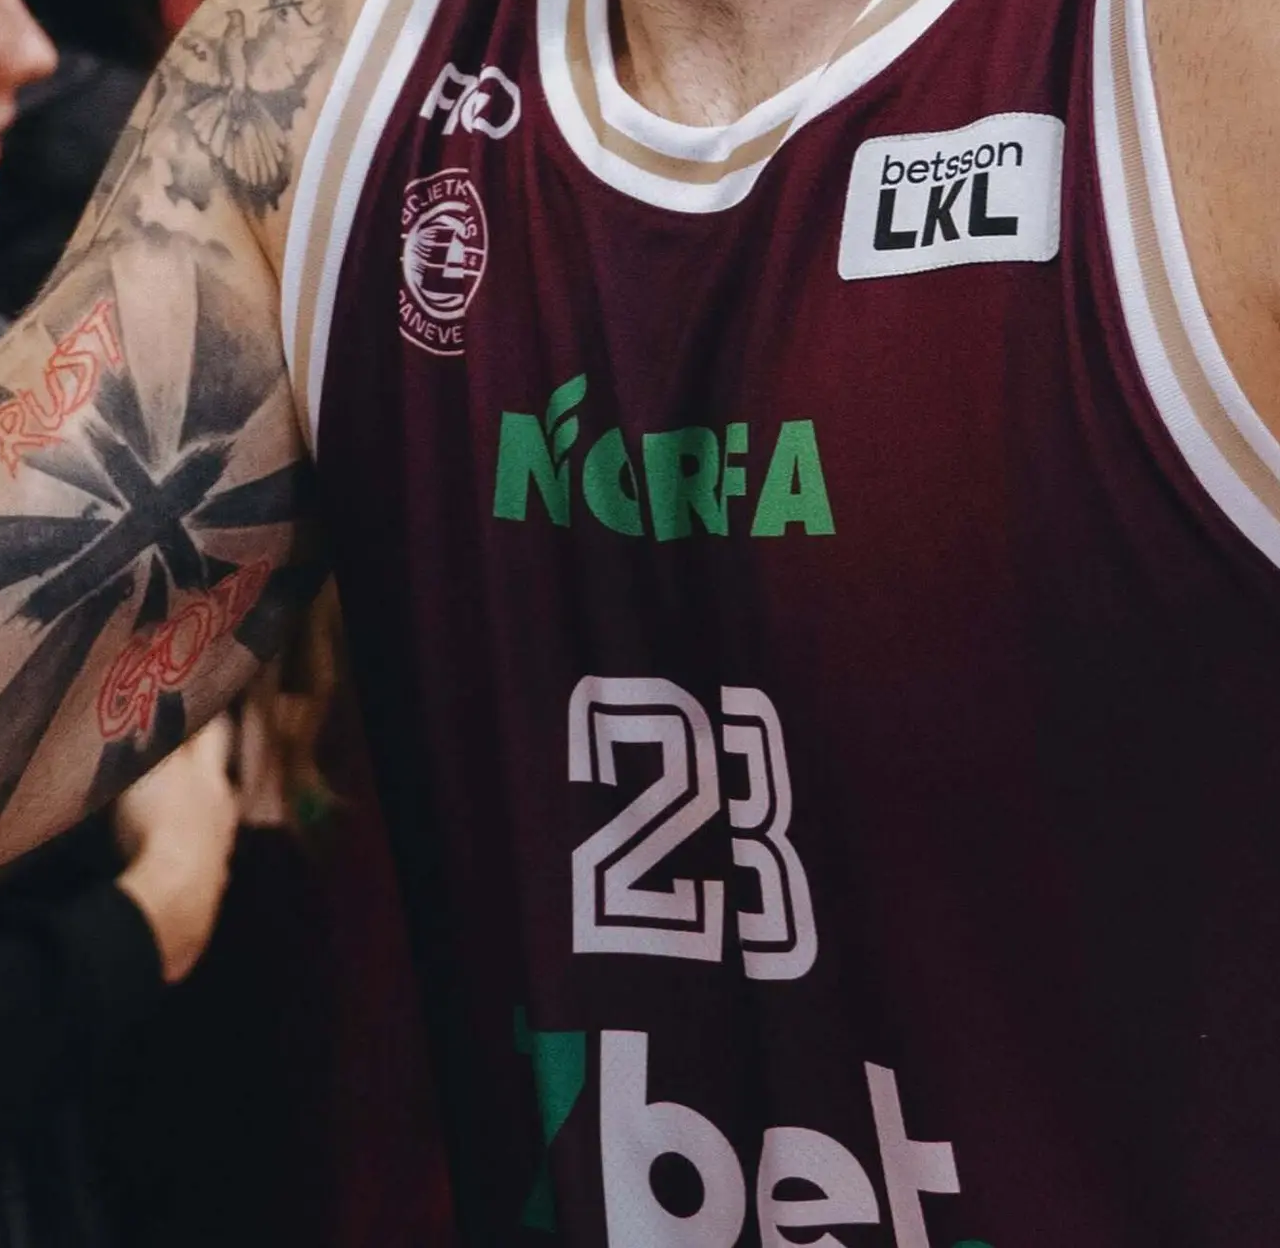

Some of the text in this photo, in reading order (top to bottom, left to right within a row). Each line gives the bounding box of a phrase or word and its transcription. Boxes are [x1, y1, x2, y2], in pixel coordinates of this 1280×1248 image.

[881, 141, 1023, 185] betsson
[873, 171, 1019, 251] LKL
[568, 674, 818, 980] 23
